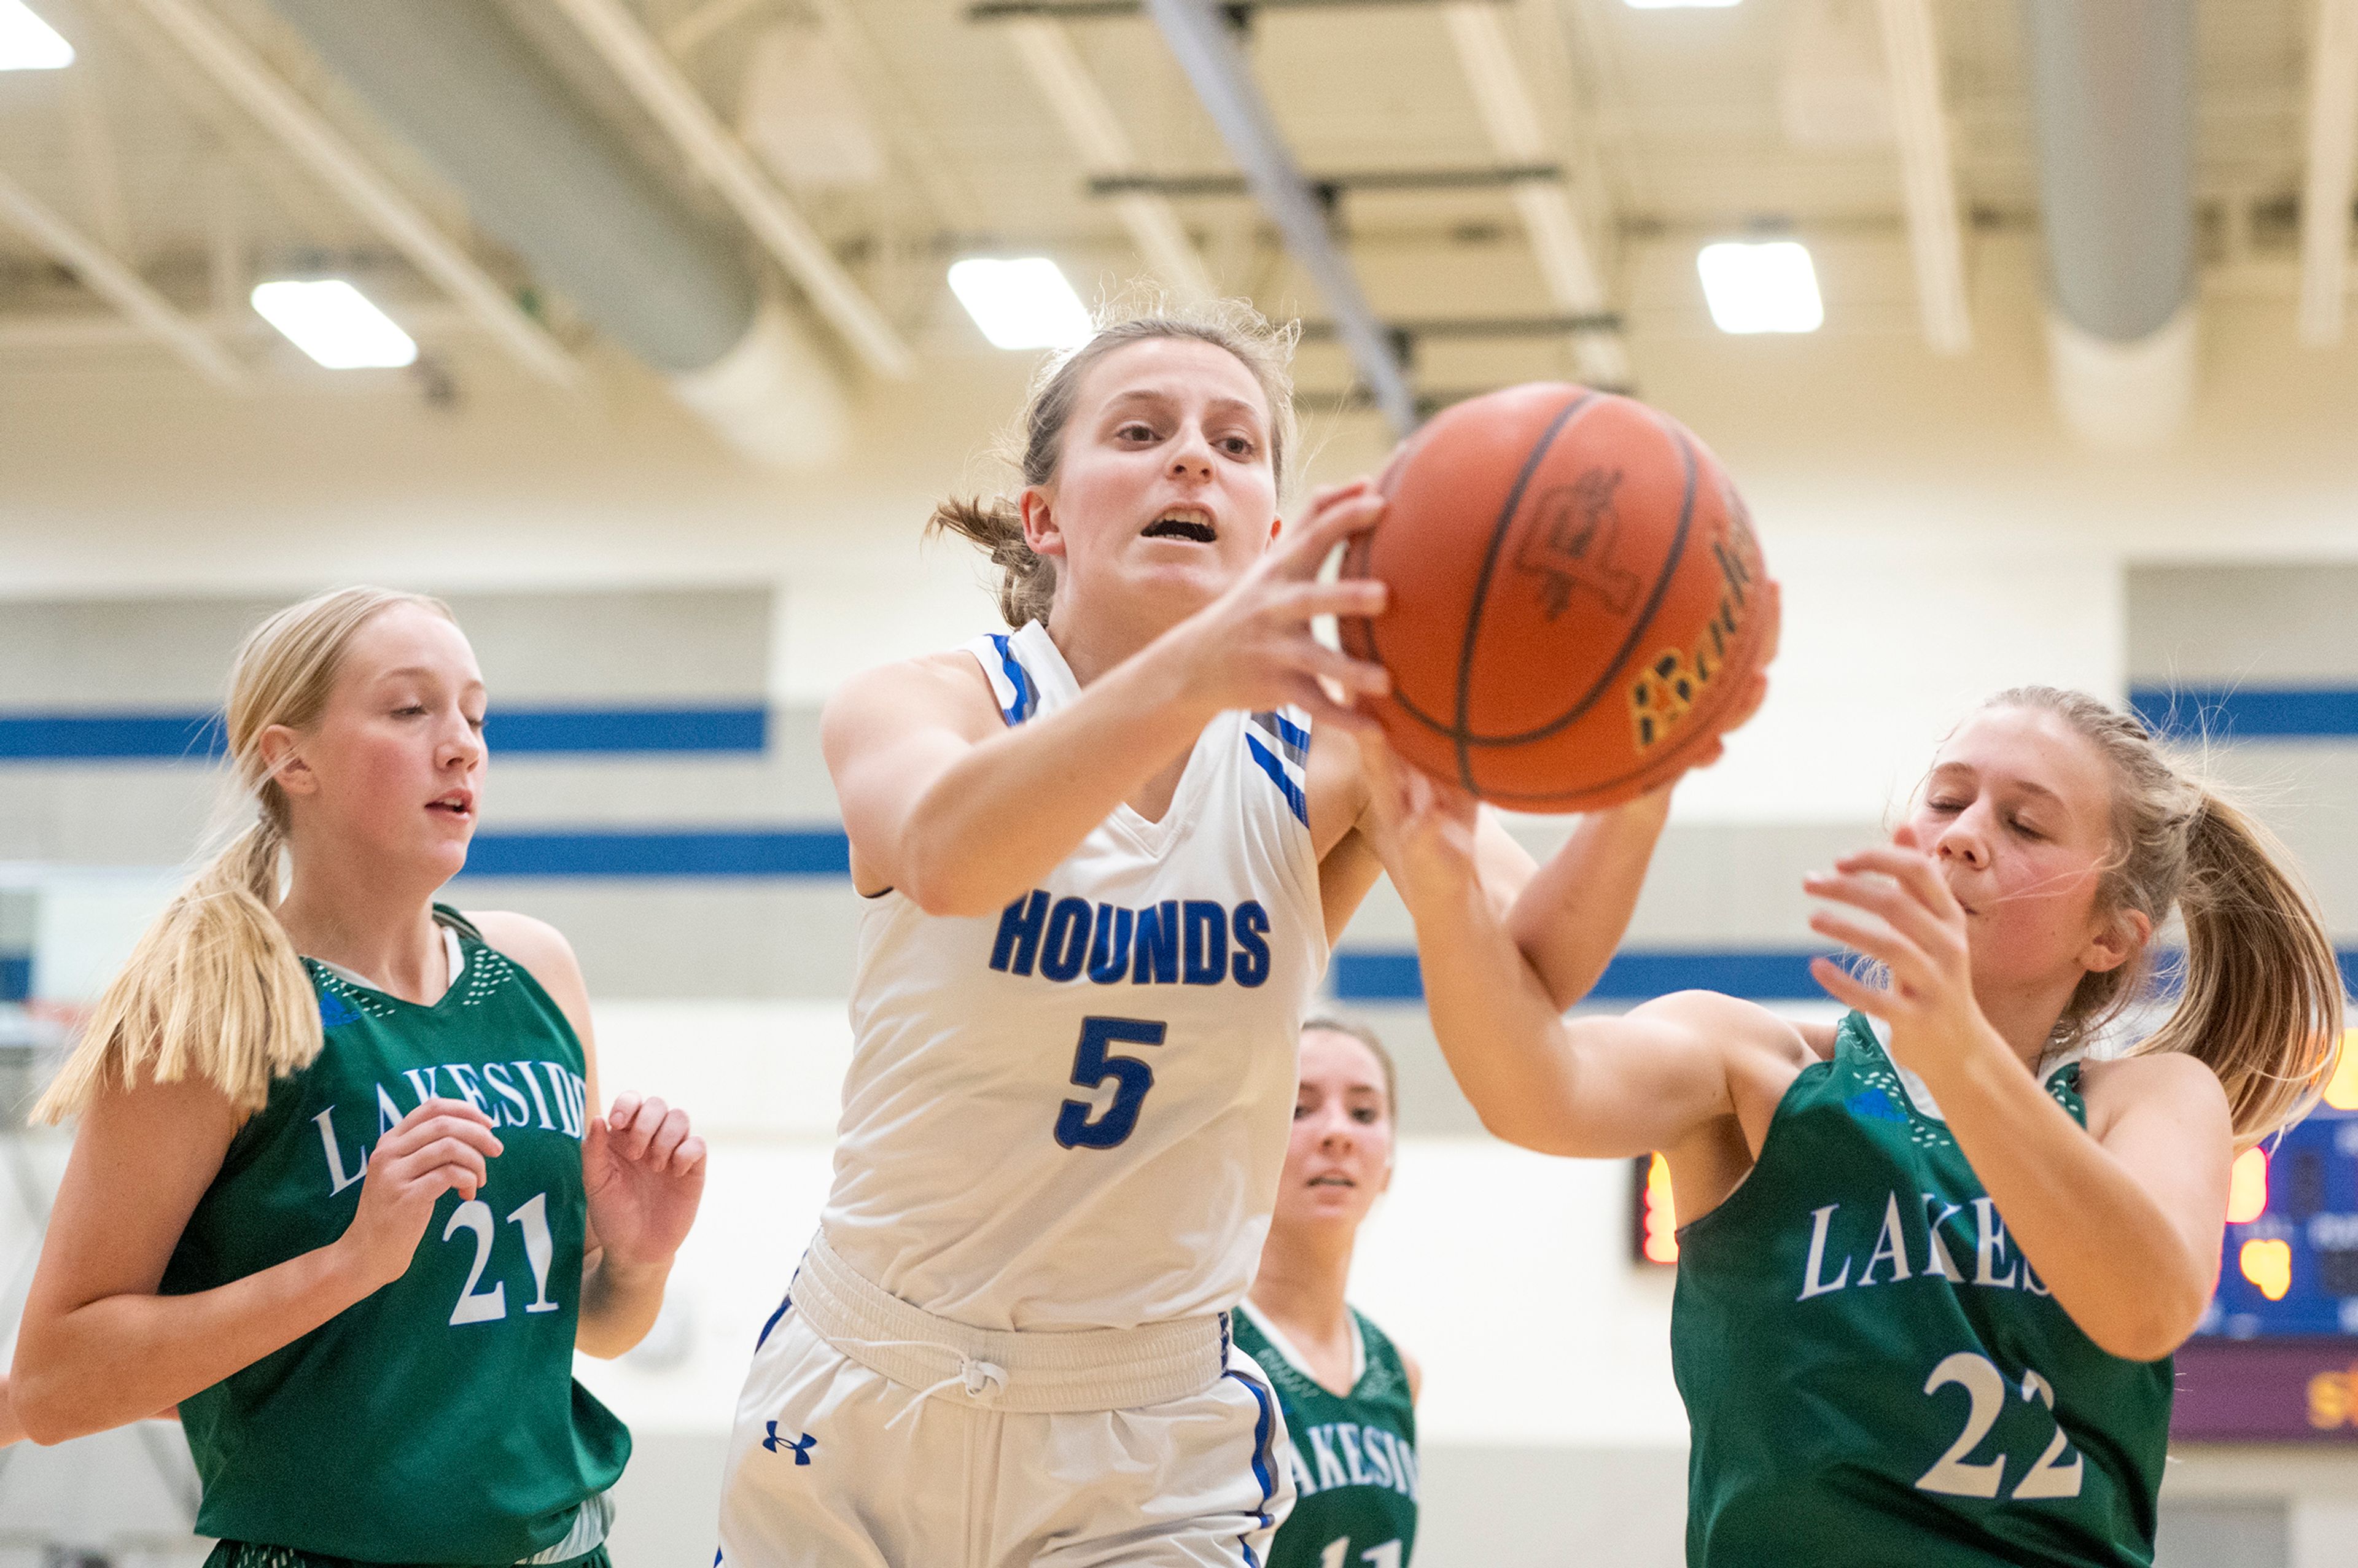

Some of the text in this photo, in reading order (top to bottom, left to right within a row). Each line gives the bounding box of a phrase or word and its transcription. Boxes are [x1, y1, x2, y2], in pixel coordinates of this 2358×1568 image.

[989, 889, 1271, 988] HOUNDS
[1054, 1015, 1167, 1150] 5
[442, 1192, 559, 1327] 21
[1290, 1422, 1417, 1500] AKESI
[1914, 1351, 2084, 1500] 22
